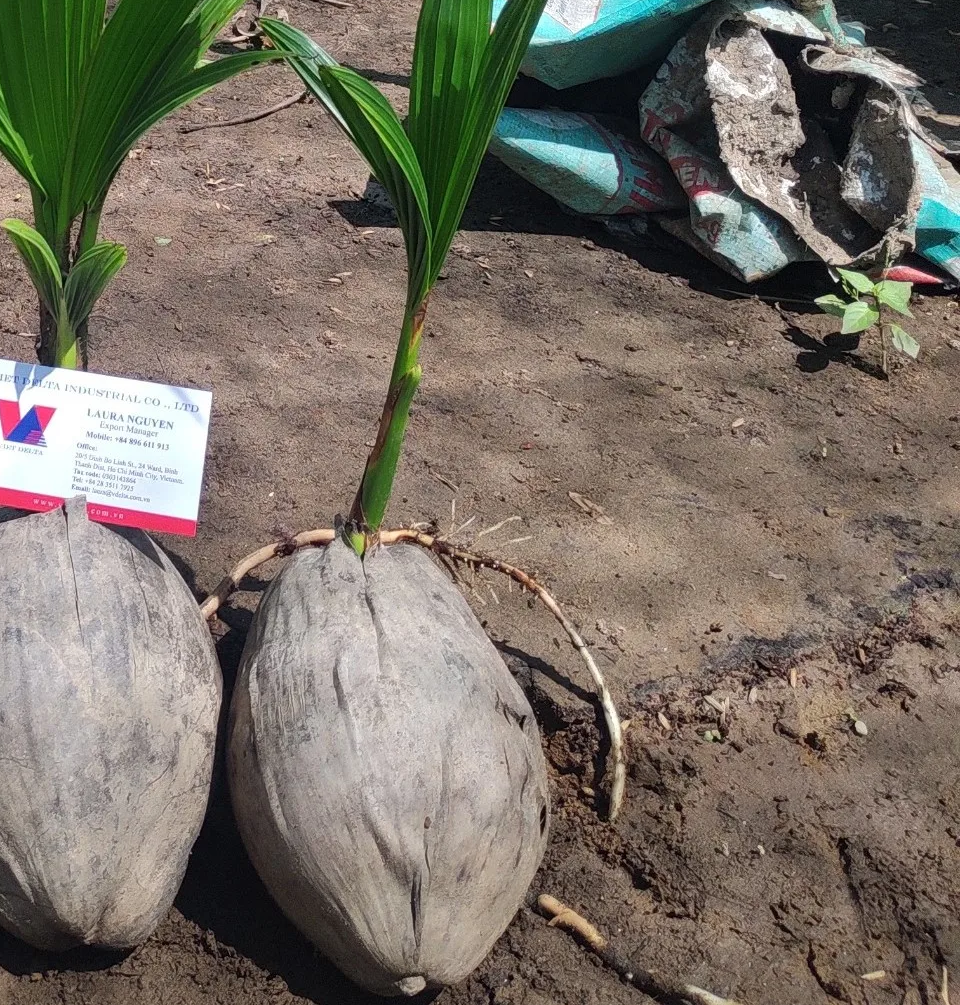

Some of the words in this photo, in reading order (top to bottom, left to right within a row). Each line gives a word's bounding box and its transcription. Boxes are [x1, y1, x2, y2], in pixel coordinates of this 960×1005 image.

[23, 377, 60, 391] DELTA
[65, 384, 141, 404] INDUSTRIAL
[144, 396, 161, 407] CO
[174, 401, 200, 413] LTD
[86, 408, 124, 422] LAURA
[127, 414, 175, 430] NGUYEN
[100, 420, 124, 432] Export
[126, 425, 159, 438] Manager
[76, 442, 98, 452] Office:
[85, 430, 113, 442] Mobile:
[114, 436, 128, 444] +84
[129, 437, 142, 447] 896
[144, 440, 155, 449] 611
[157, 442, 170, 451] 913
[18, 446, 43, 456] DELTA
